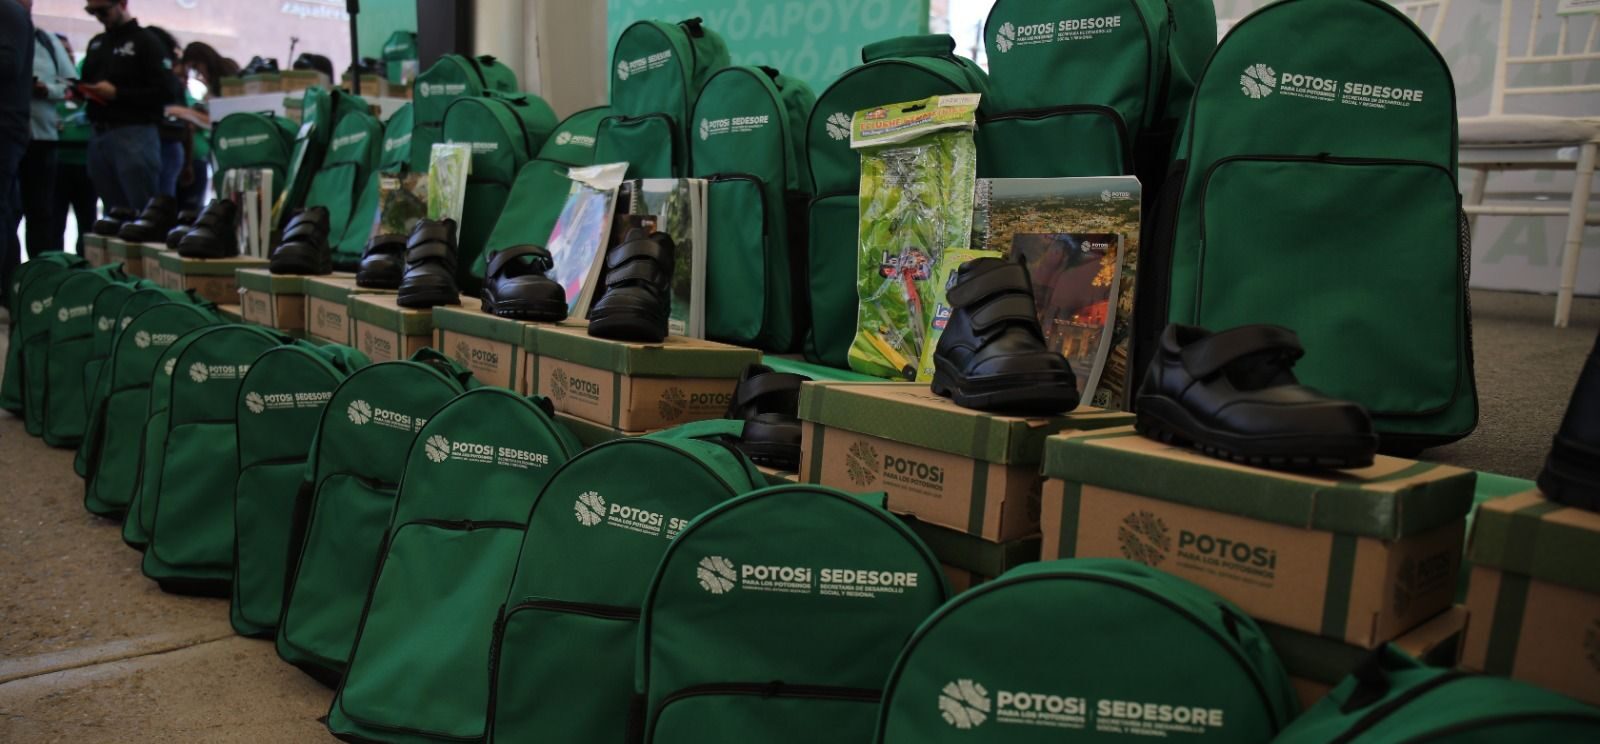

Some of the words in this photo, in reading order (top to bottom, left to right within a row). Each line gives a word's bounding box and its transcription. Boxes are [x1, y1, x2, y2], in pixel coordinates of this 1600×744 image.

[1058, 16, 1121, 31] SEDESORE
[1343, 82, 1424, 103] SEDESORE
[731, 115, 769, 126] SEDESORE
[498, 447, 549, 465] SEDESORE
[883, 471, 898, 481] PARA
[898, 475, 910, 483] LOS
[608, 515, 622, 524] PARA
[1177, 550, 1201, 561] PARA
[1202, 556, 1220, 566] LOS
[820, 568, 918, 587] SEDESORE
[820, 588, 840, 597] SOCIAL
[855, 584, 863, 592] DE
[996, 708, 1019, 718] PARA
[1097, 699, 1224, 728] SEDESORE
